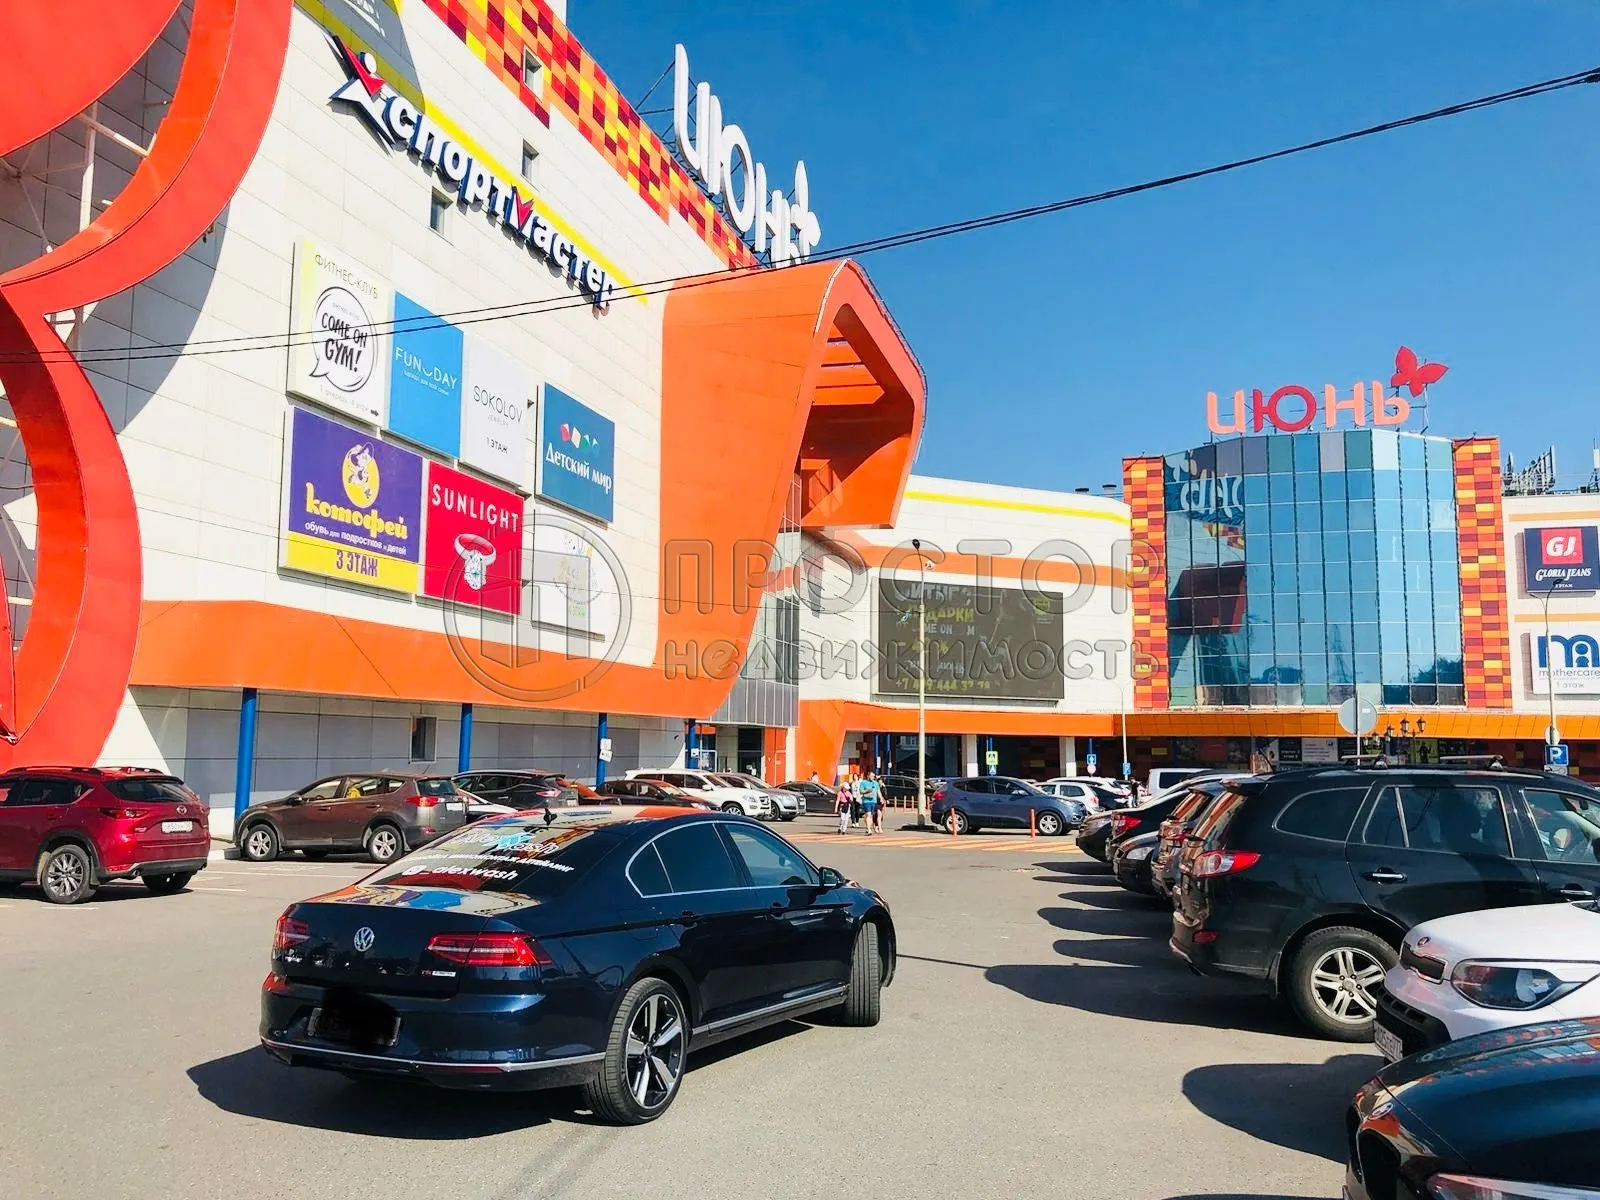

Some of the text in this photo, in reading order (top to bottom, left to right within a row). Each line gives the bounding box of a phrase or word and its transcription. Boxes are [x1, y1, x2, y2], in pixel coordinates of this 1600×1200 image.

[322, 312, 368, 349] COME ON
[324, 338, 362, 373] GYM!
[395, 347, 458, 389] FUN DAY
[473, 385, 523, 422] SOKOLOV
[490, 438, 508, 454] ЭТАЖ
[545, 442, 612, 494] Детский мир
[305, 481, 408, 540] котофей
[431, 483, 519, 533] SUNLIGHT
[304, 521, 330, 535] обувь
[341, 531, 383, 549] подростков
[387, 545, 407, 556] детей
[346, 551, 378, 577] ЭТАЖ
[1535, 567, 1592, 582] GLORIA JEANS
